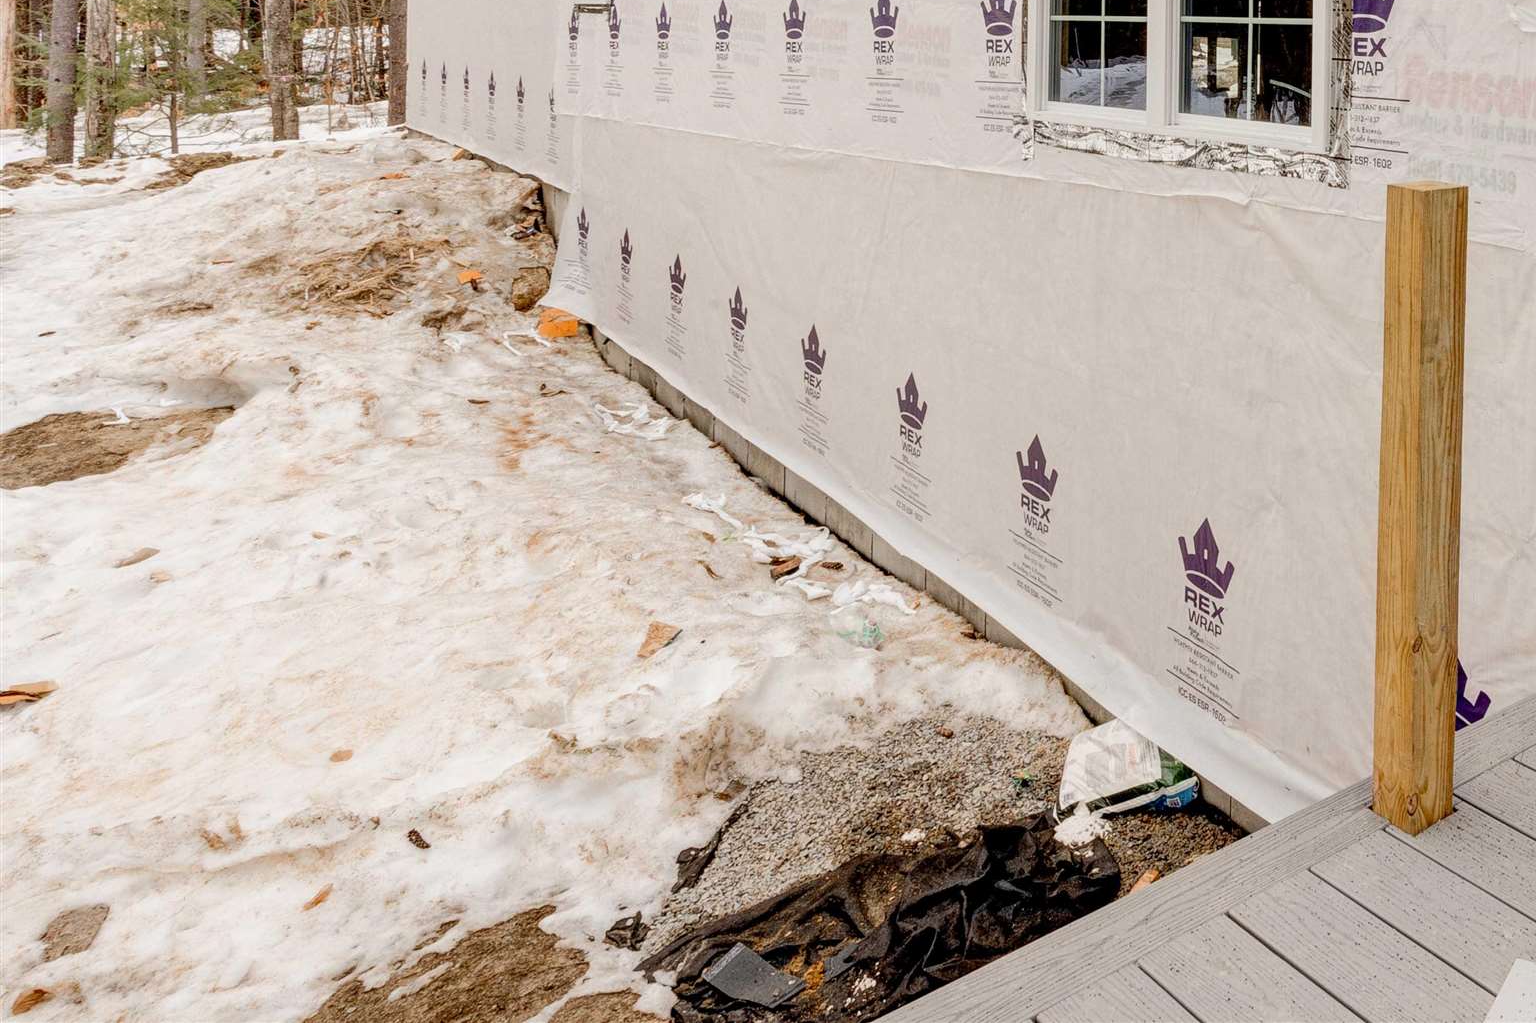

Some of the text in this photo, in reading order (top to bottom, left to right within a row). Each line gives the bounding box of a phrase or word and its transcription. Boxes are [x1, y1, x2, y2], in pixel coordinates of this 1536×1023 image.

[785, 41, 803, 53] REX
[873, 41, 895, 53] REX
[985, 39, 1013, 54] REX
[1353, 37, 1387, 58] EX
[988, 55, 1011, 67] WRAP
[803, 370, 822, 391] REX
[900, 425, 922, 449] REX
[1020, 493, 1050, 523] REX
[1024, 512, 1049, 534] WRAP
[1184, 585, 1225, 626] REX
[1188, 608, 1223, 639] WRAP
